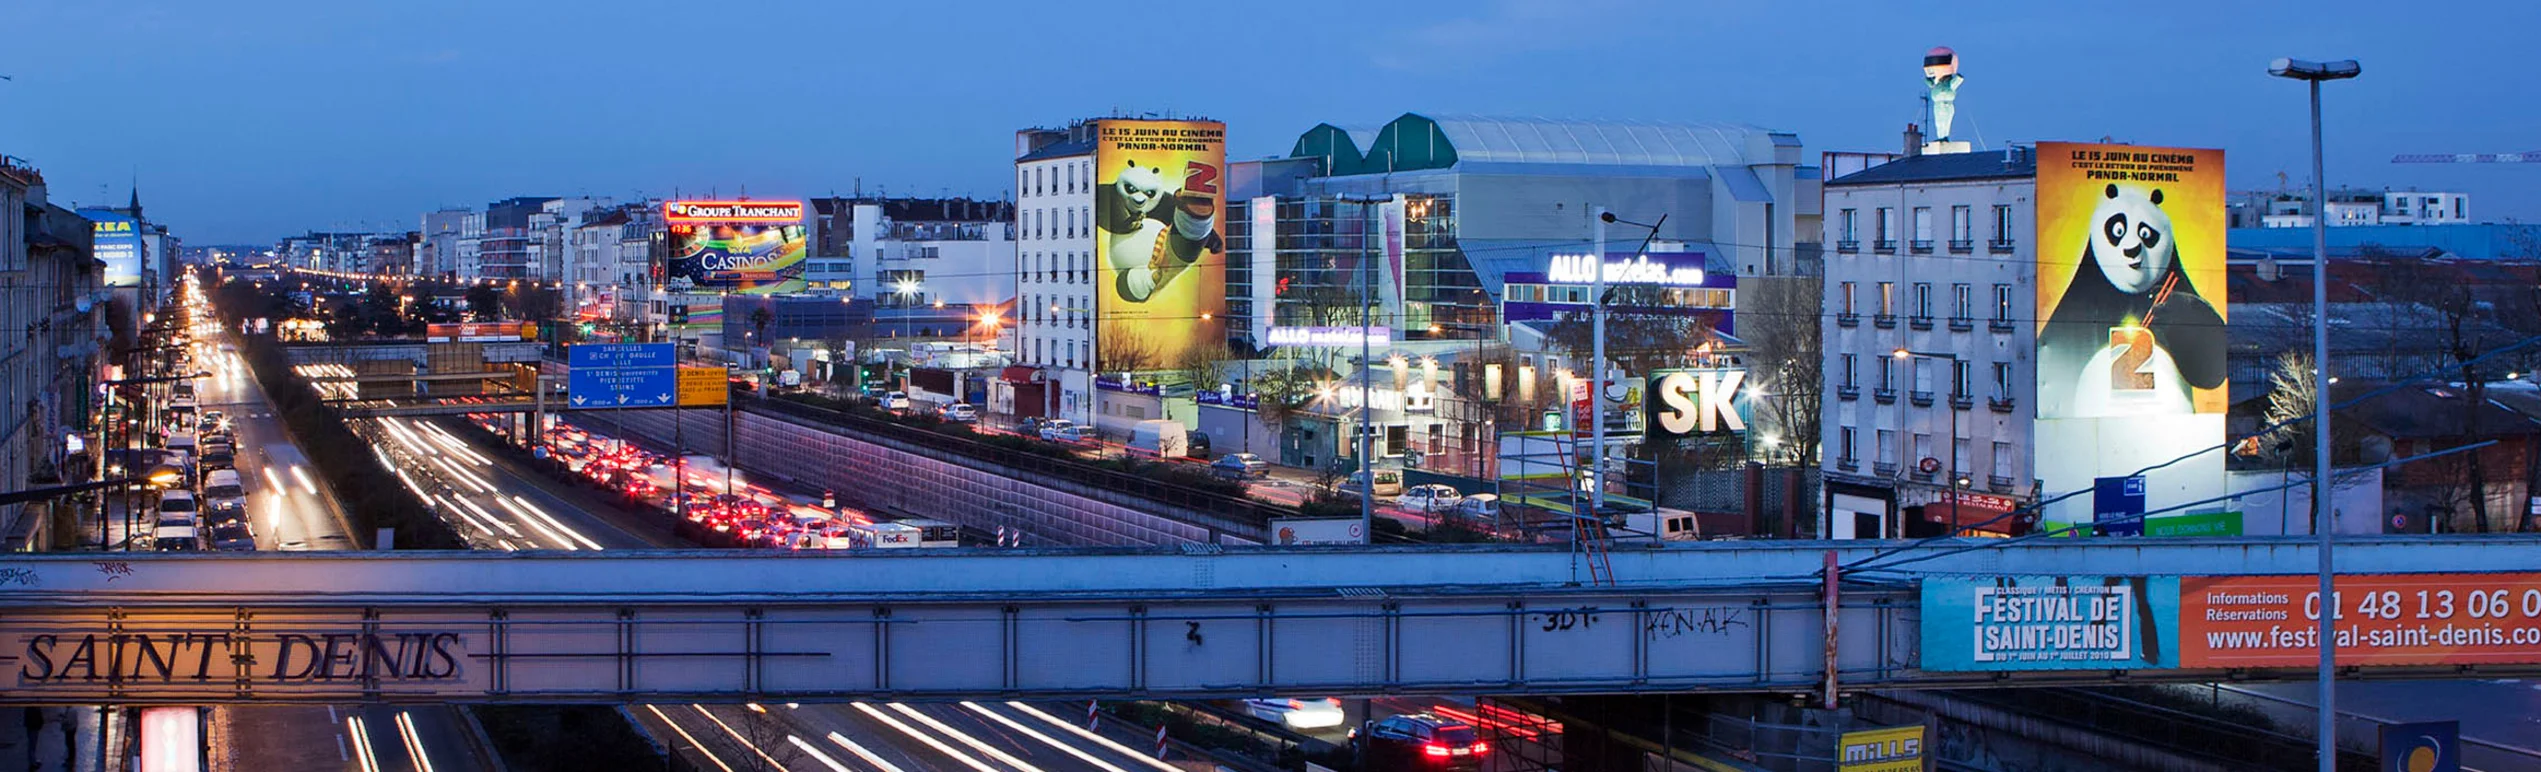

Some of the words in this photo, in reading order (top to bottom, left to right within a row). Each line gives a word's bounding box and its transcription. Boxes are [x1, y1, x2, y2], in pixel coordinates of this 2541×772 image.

[1132, 128, 1159, 136] JUIN
[1162, 129, 1177, 137] AU
[1180, 128, 1223, 138] CINÉMA
[1117, 143, 1209, 152] PANDA-NORMAL
[2072, 151, 2085, 160] LE
[2089, 151, 2100, 161] 15
[2103, 152, 2130, 162] JUIN
[2133, 153, 2148, 163] AU
[2151, 153, 2194, 165] CINÉMA
[1183, 160, 1219, 197] 2
[2087, 170, 2179, 183] PANDA-NORMAL
[687, 205, 731, 217] GROUPE
[732, 205, 800, 217] TRANCHANT
[94, 221, 131, 231] KEA
[1548, 254, 1597, 283] ALLO
[1268, 329, 1310, 344] ALLO
[2109, 327, 2155, 390] 2
[1658, 371, 1746, 434] SK
[1963, 501, 2008, 512] RESTAURANT
[882, 534, 908, 544] FedEx
[1996, 586, 2037, 595] CLASSIQUE
[1974, 587, 2083, 622] FESTIVAL
[2090, 597, 2119, 622] DE
[2207, 592, 2288, 605] Informations
[2304, 591, 2343, 620] 01
[2358, 591, 2401, 619] 48
[2416, 590, 2454, 619] 13
[2467, 589, 2509, 618] 06
[2207, 608, 2288, 621] Réservations
[1985, 624, 2119, 650] SAINT-DENIS
[1996, 652, 2007, 662] DU
[2019, 652, 2036, 661] JUIN
[2038, 652, 2048, 661] AU
[2060, 651, 2087, 660] JUILLET
[2090, 651, 2109, 660] 2010
